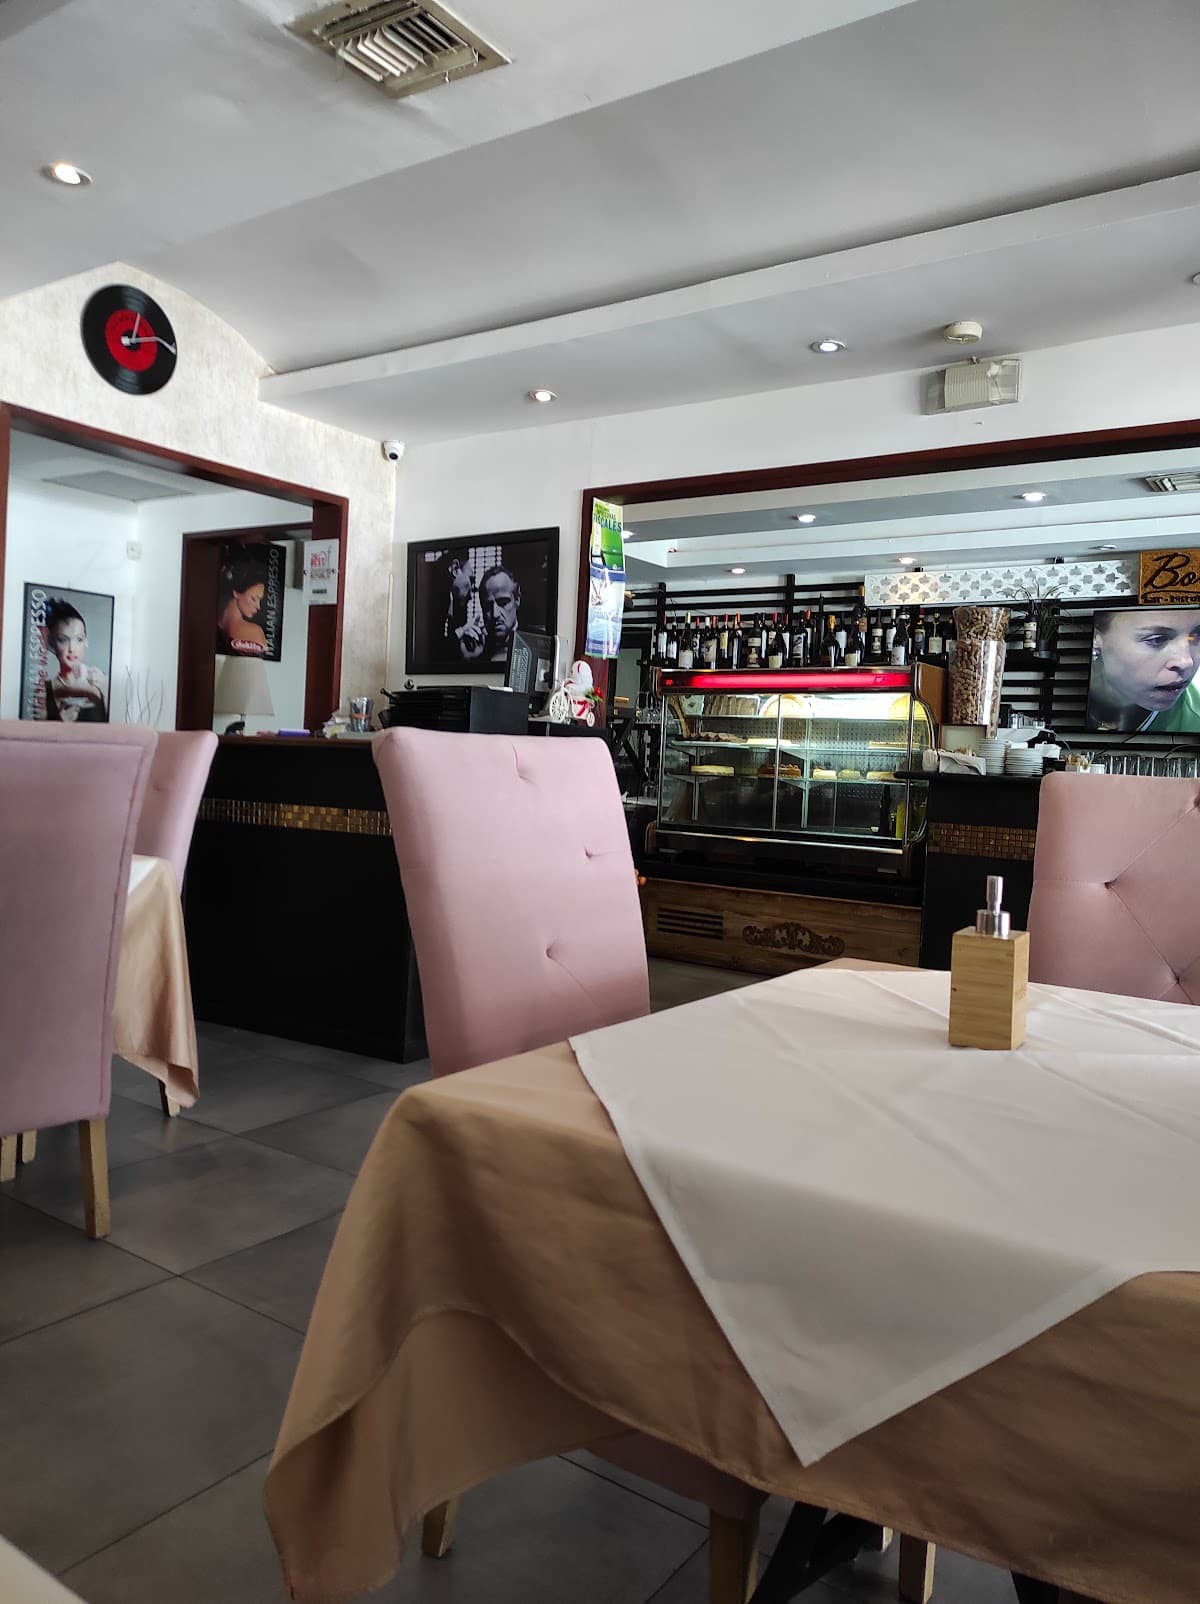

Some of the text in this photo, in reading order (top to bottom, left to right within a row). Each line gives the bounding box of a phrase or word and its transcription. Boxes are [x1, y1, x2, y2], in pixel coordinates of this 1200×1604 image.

[265, 548, 280, 656] ITALIAN ESPRESSO
[1143, 552, 1200, 589] Bo
[29, 589, 47, 661] ESPRESSO
